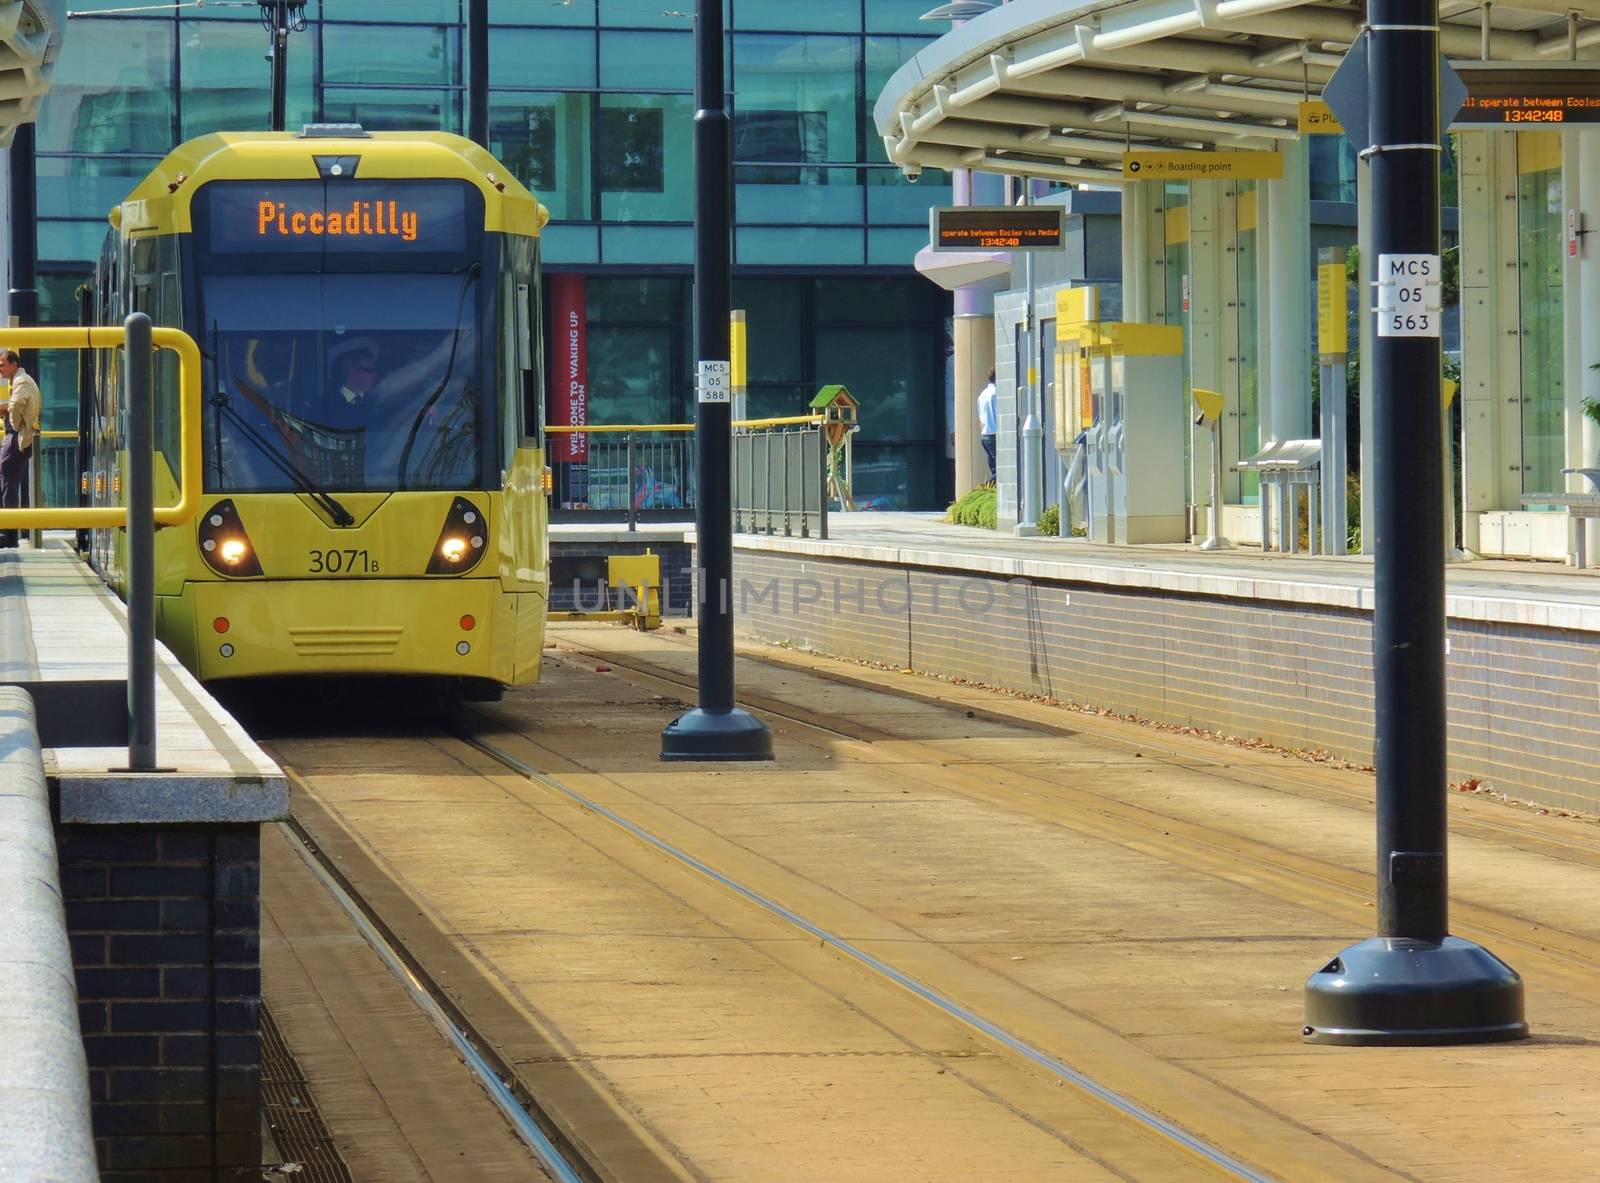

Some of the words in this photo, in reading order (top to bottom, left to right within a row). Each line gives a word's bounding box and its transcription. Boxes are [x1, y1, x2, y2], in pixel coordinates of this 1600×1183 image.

[1479, 98, 1519, 108] operate
[1523, 97, 1563, 107] between
[1505, 110, 1563, 122] 13:42:48
[1168, 162, 1207, 174] Boarding
[1208, 163, 1232, 173] point
[258, 200, 417, 241] Piccadilly
[970, 229, 998, 237] between
[1391, 260, 1430, 276] MCS
[1399, 287, 1422, 303] 05
[570, 311, 578, 328] UP
[1393, 315, 1429, 330] 563
[570, 329, 578, 379] WAKING
[704, 364, 725, 372] MCS
[570, 380, 578, 397] TO
[708, 377, 721, 386] 05
[706, 391, 725, 400] 588
[570, 399, 579, 456] WELOME
